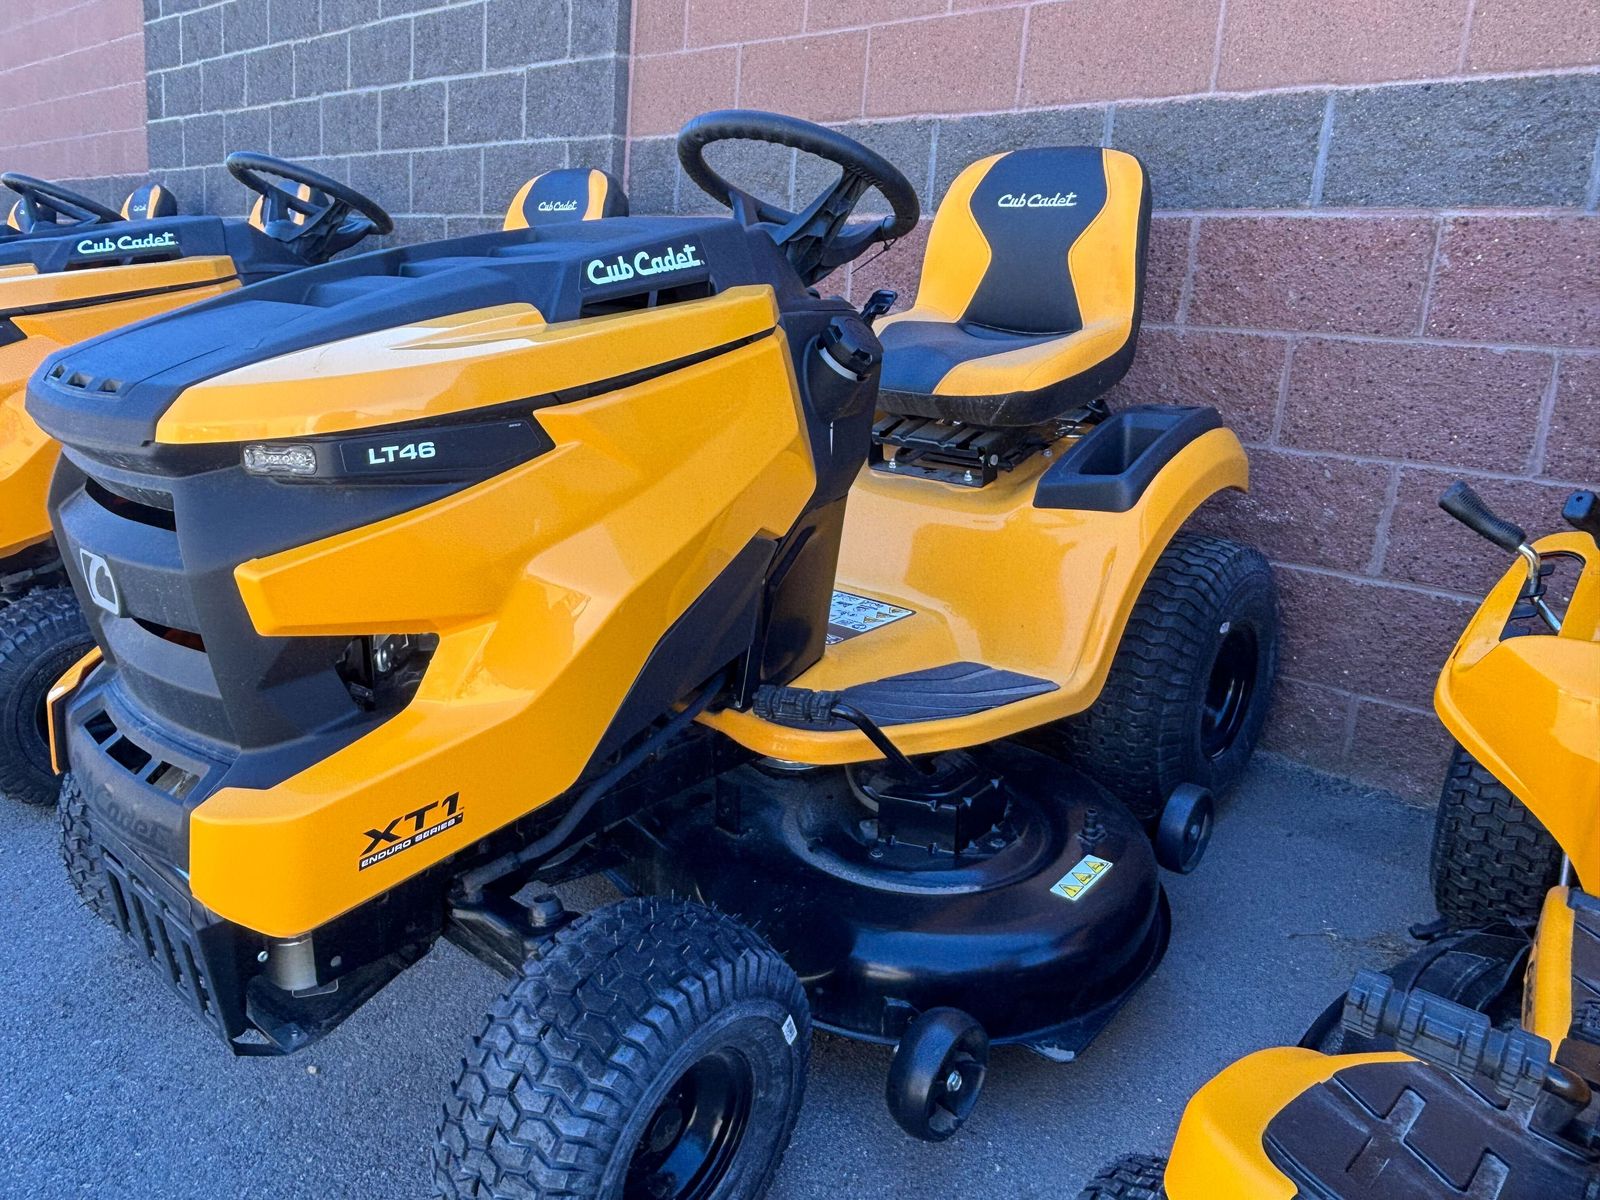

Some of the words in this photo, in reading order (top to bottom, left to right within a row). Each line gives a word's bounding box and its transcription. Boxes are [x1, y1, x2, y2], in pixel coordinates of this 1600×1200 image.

[538, 201, 554, 212] Cub
[553, 200, 578, 211] Cadet
[997, 193, 1027, 208] Cub
[1027, 191, 1078, 207] Cadet
[77, 237, 116, 254] Cub
[116, 231, 176, 250] Cadet
[587, 255, 635, 285] Cub
[633, 243, 702, 276] Cadet
[368, 441, 437, 465] LT46
[359, 791, 460, 857] XT1
[361, 839, 412, 868] ENDURO
[414, 817, 457, 842] SERIES
